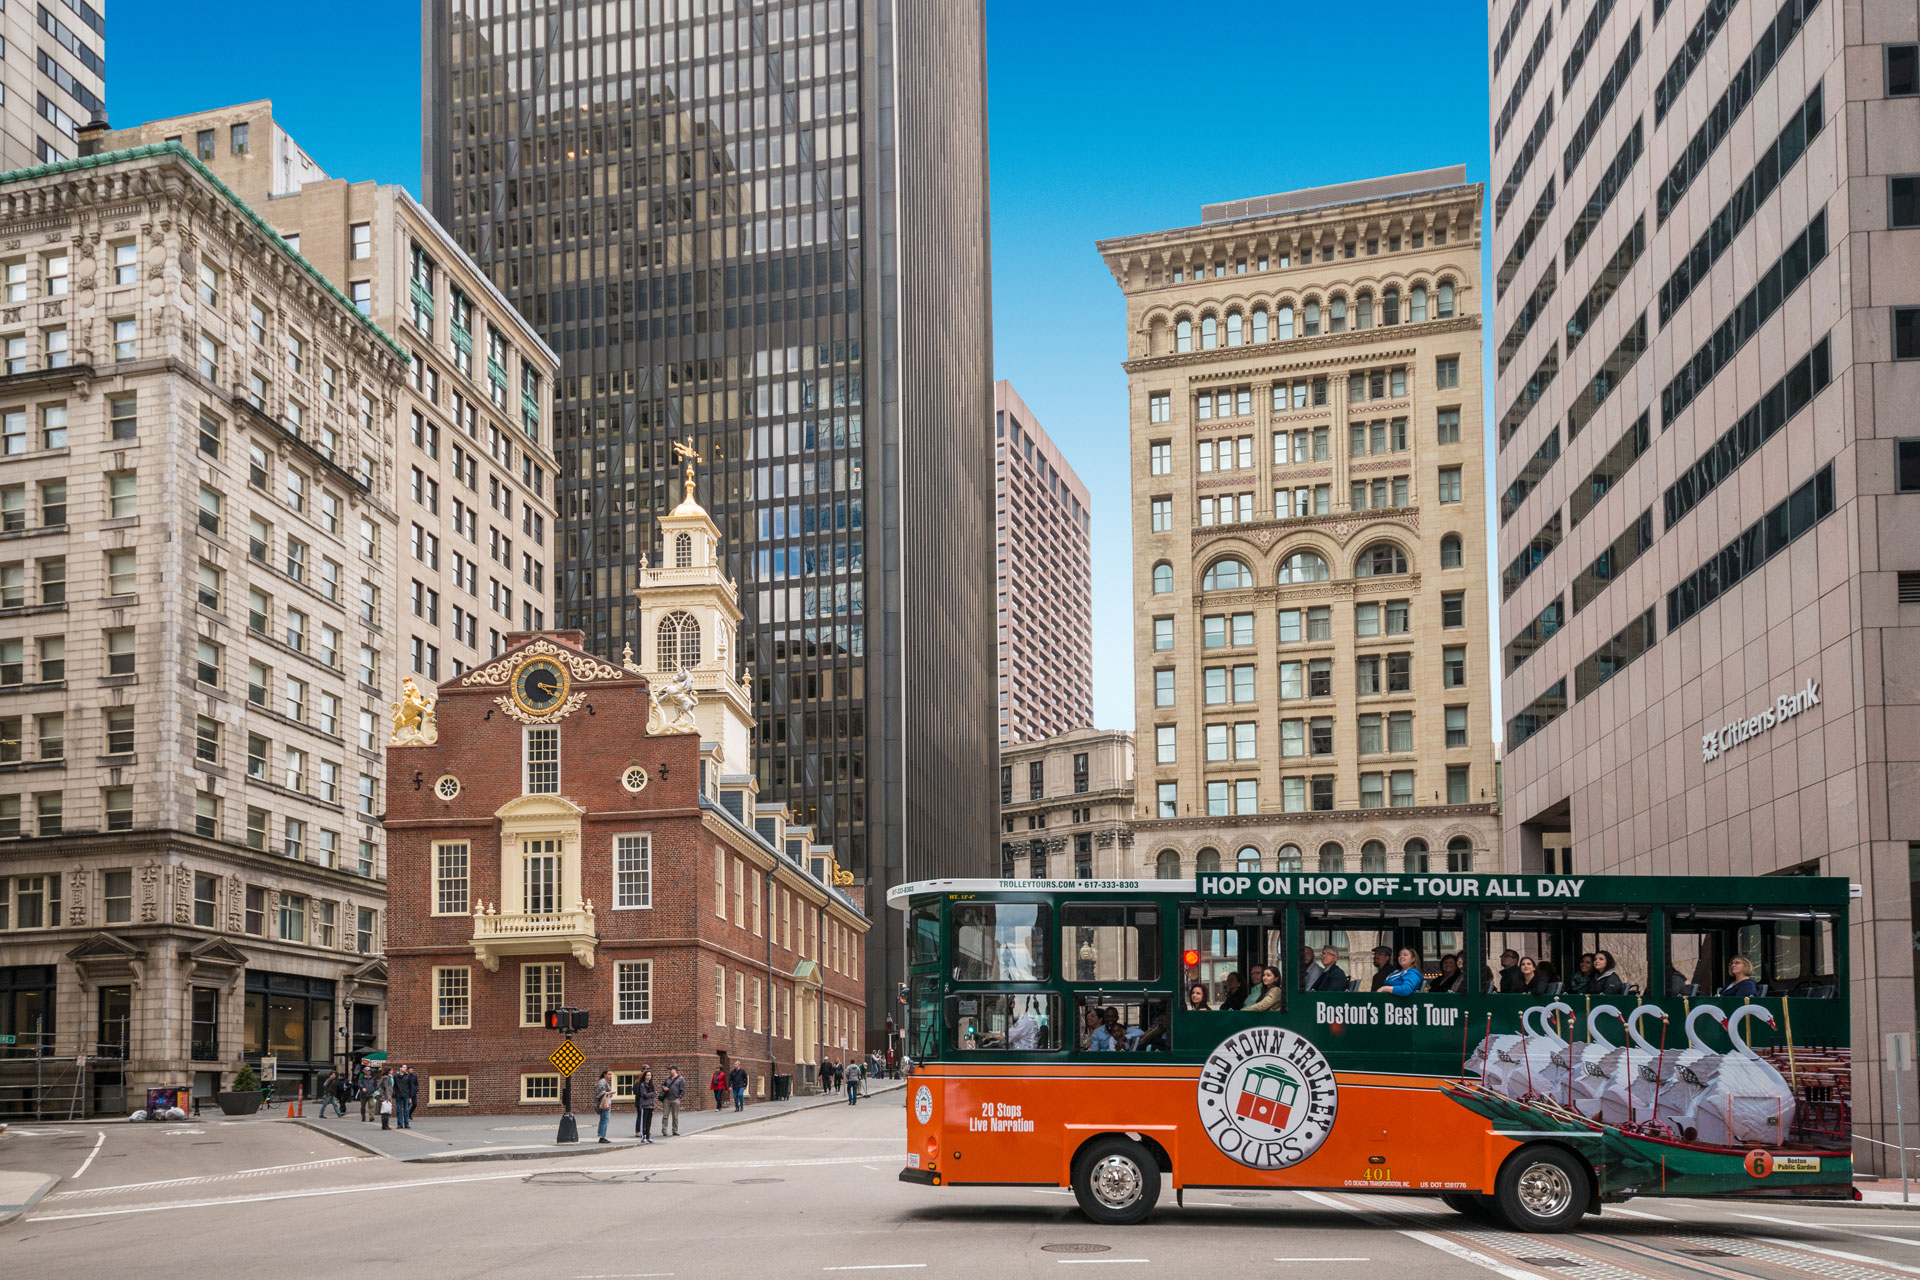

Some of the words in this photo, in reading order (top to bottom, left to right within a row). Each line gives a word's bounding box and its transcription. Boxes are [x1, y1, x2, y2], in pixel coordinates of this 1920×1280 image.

[1720, 707, 1775, 751] Citizens
[1777, 678, 1820, 723] Bank
[999, 881, 1075, 889] TROLLEYTOURS.COM
[1084, 881, 1139, 889] 617-333-8303
[1203, 877, 1251, 895] HOP
[1258, 877, 1291, 895] ON
[1299, 877, 1348, 895] HOP
[1485, 878, 1530, 897] ALL
[1537, 879, 1585, 897] DAY
[1316, 1002, 1379, 1025] Boston's
[1385, 1002, 1418, 1026] Best
[1424, 1003, 1459, 1026] Tour
[1201, 1055, 1232, 1095] OLD
[1224, 1029, 1285, 1061] TOWN
[1288, 1037, 1335, 1132] TROLLEY
[982, 1102, 994, 1117] 20
[997, 1102, 1022, 1119] Stops
[969, 1117, 988, 1132] Live
[990, 1117, 1034, 1132] Narration
[1207, 1109, 1304, 1167] TOURS
[1363, 1168, 1392, 1181] 401
[1753, 1158, 1765, 1175] 6
